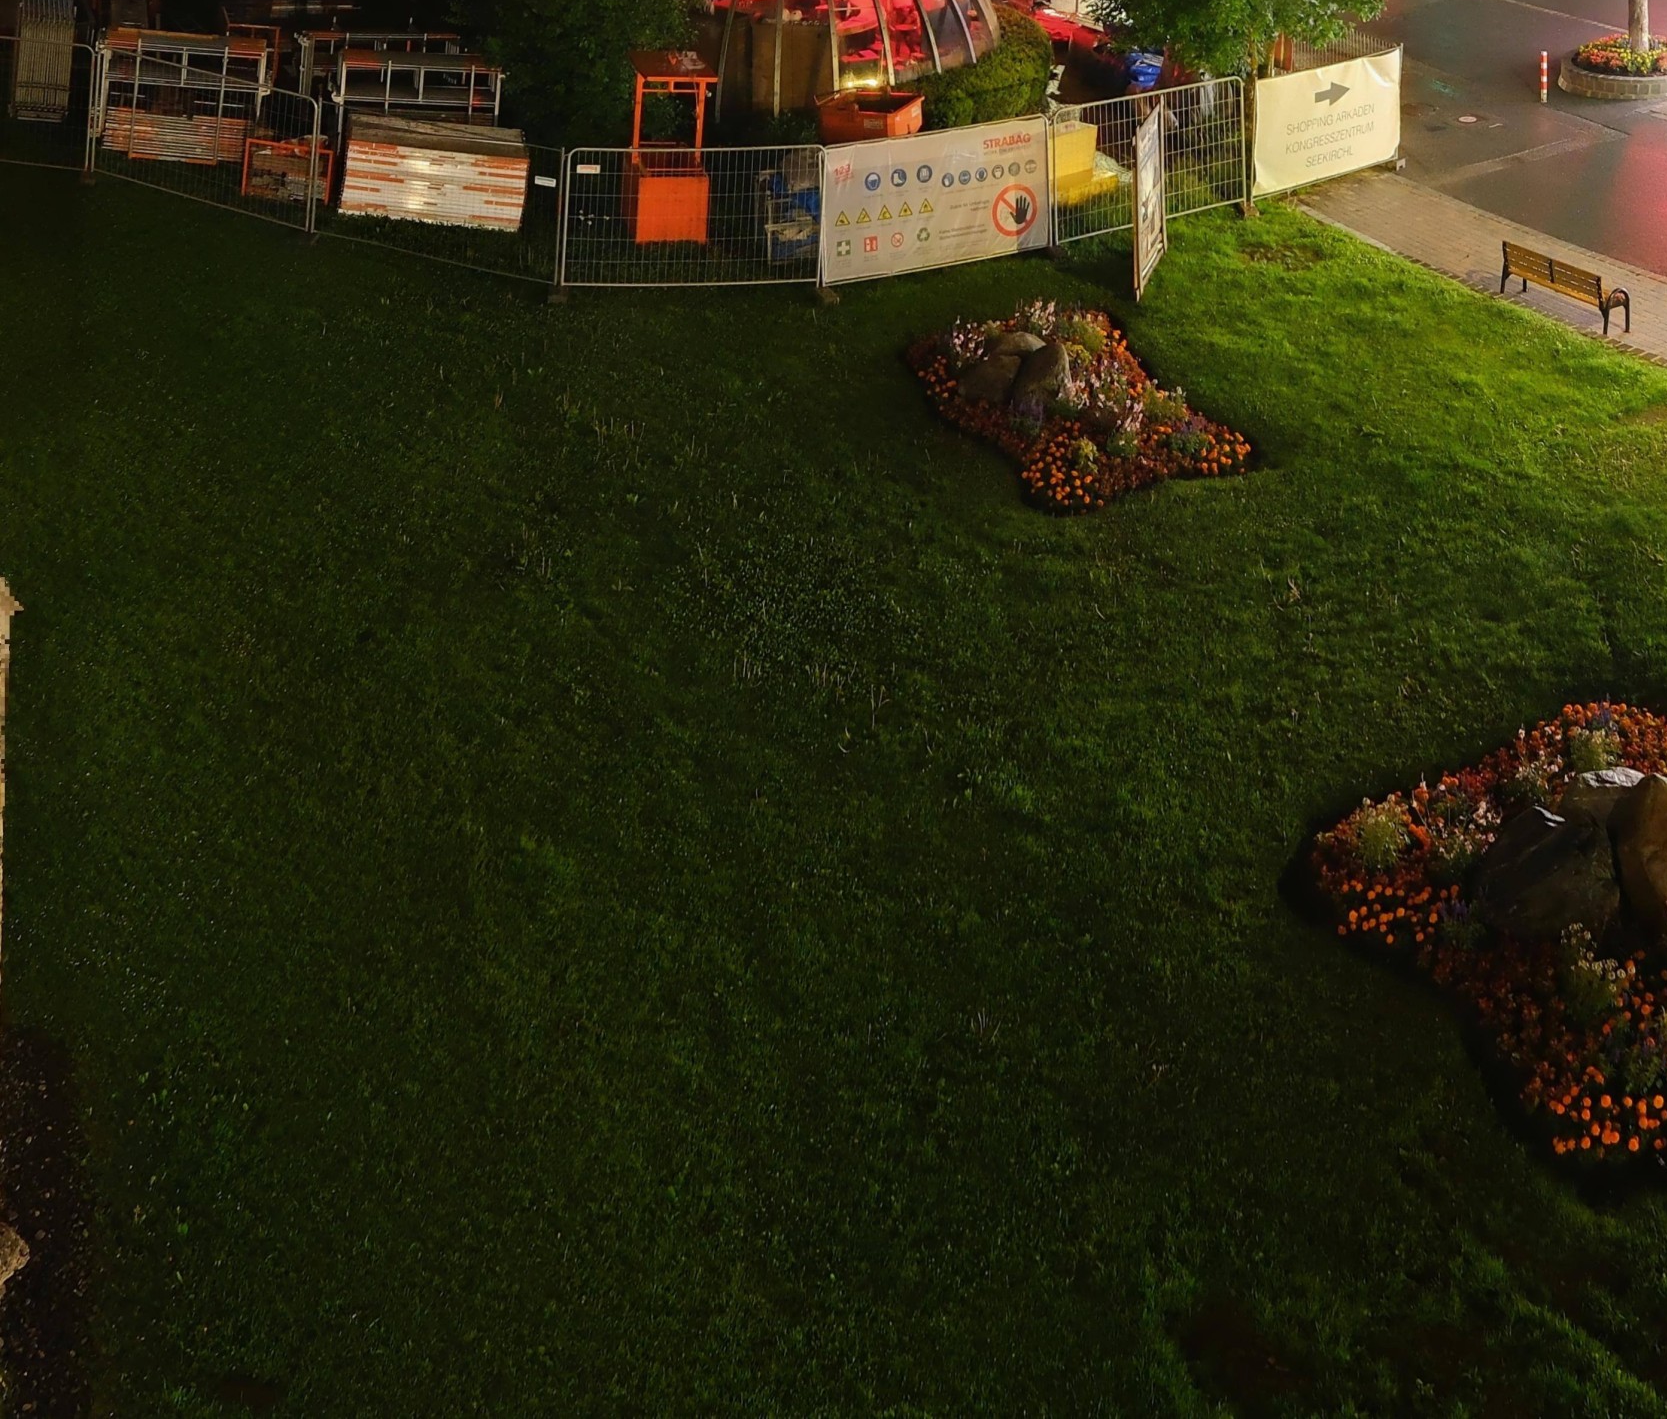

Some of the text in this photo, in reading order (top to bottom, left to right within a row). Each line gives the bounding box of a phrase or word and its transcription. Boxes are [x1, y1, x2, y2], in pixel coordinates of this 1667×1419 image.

[1286, 103, 1375, 136] SHOPPING ARKADEN
[983, 133, 1032, 150] STRABAG
[1286, 121, 1375, 155] KONGRESSZENTRUM
[1305, 145, 1354, 168] SEEKIRCHL
